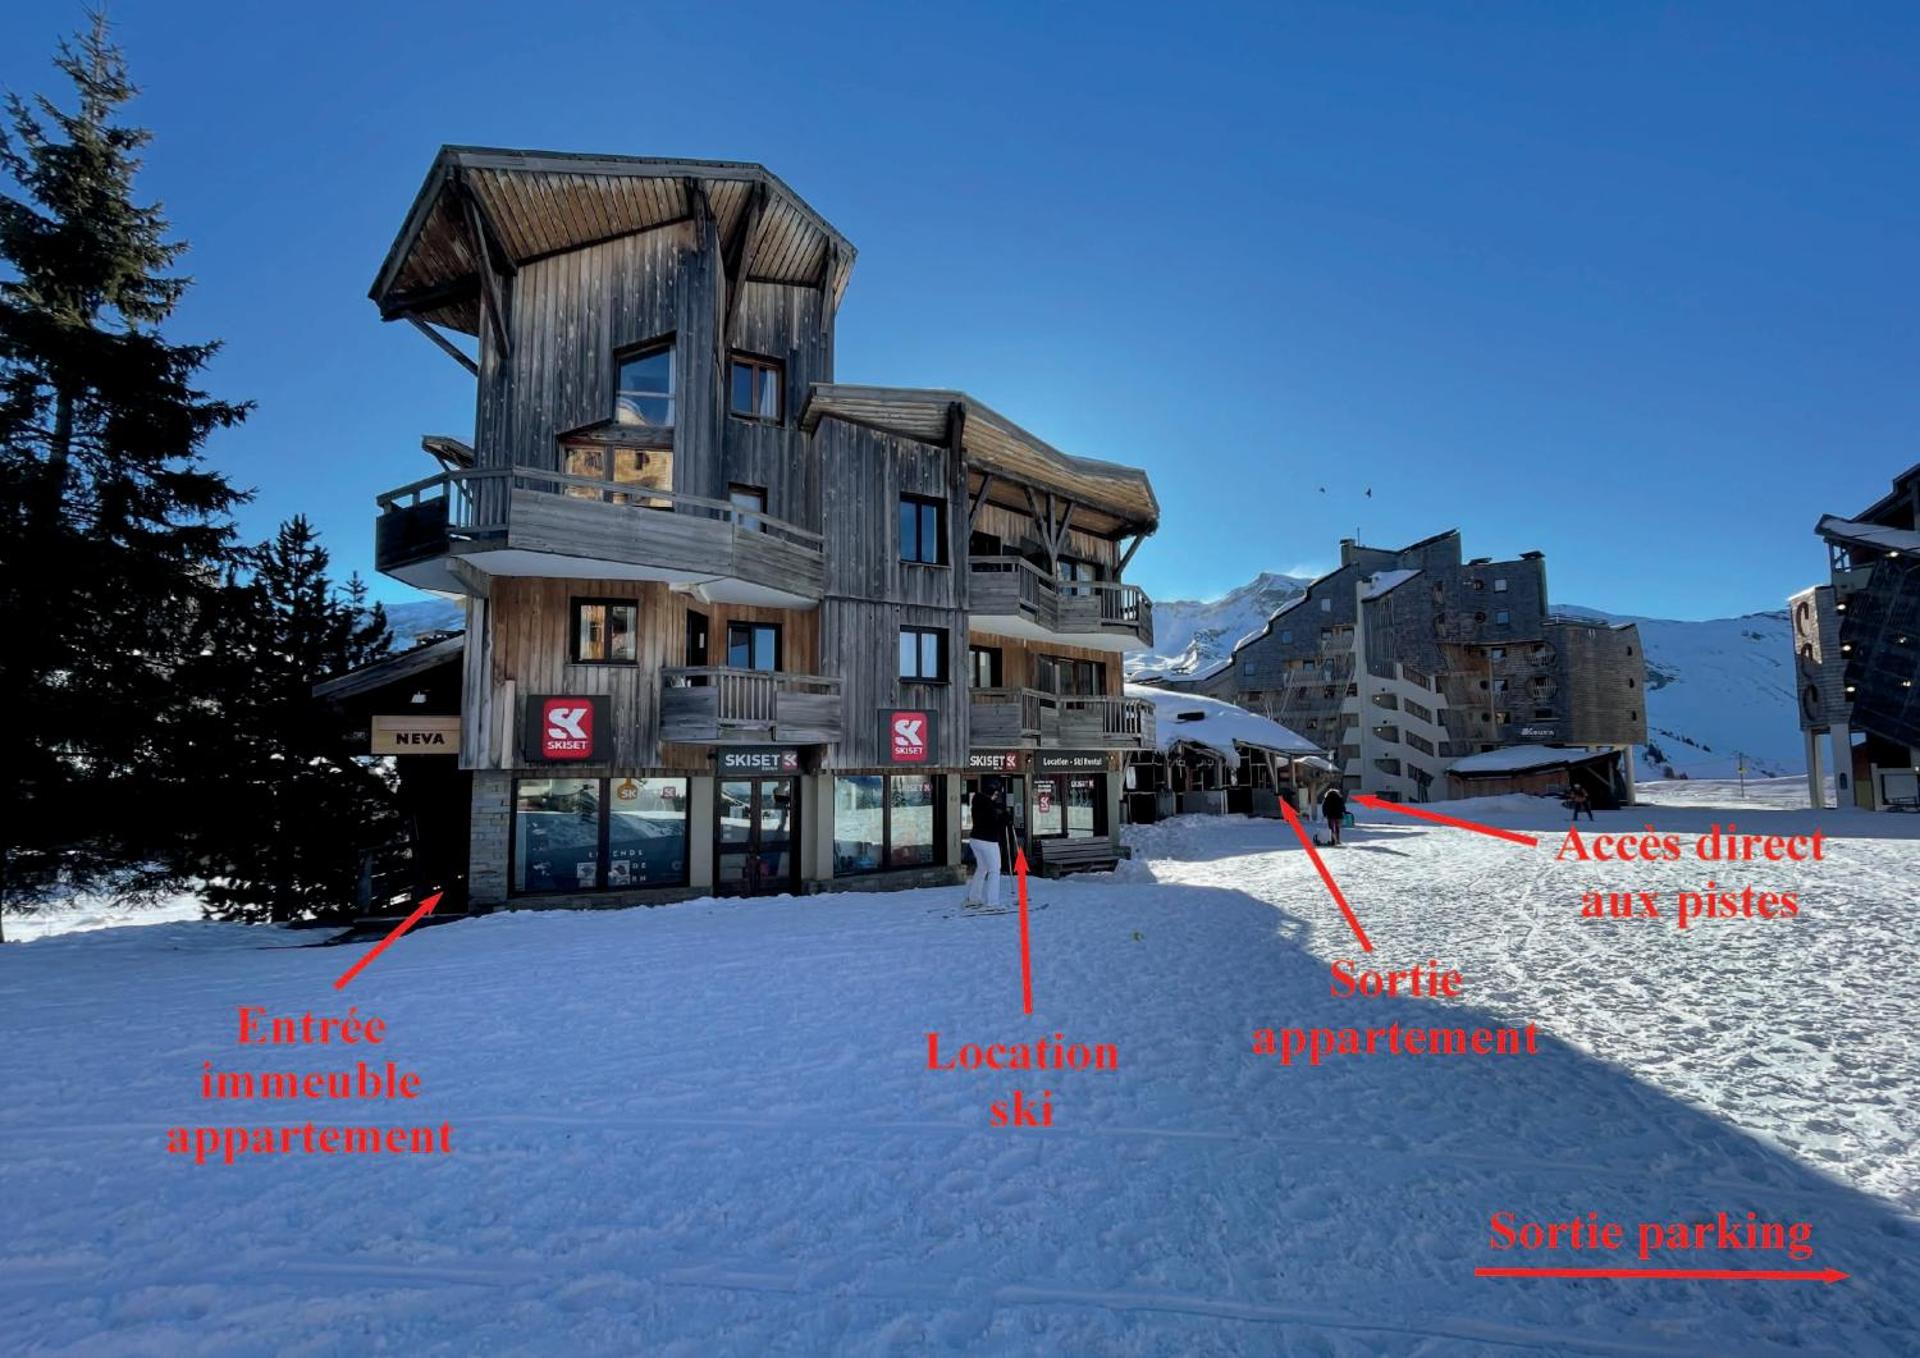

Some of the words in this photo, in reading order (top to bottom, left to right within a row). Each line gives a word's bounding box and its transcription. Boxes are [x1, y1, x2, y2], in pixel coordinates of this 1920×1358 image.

[396, 732, 446, 745] NEVA
[547, 741, 588, 751] SKISET
[894, 746, 923, 755] SKISET
[725, 754, 781, 767] SKISET
[969, 755, 1005, 767] SKISET
[1043, 757, 1068, 766] Location
[1073, 757, 1083, 765] Ski
[1084, 757, 1102, 765] Rental
